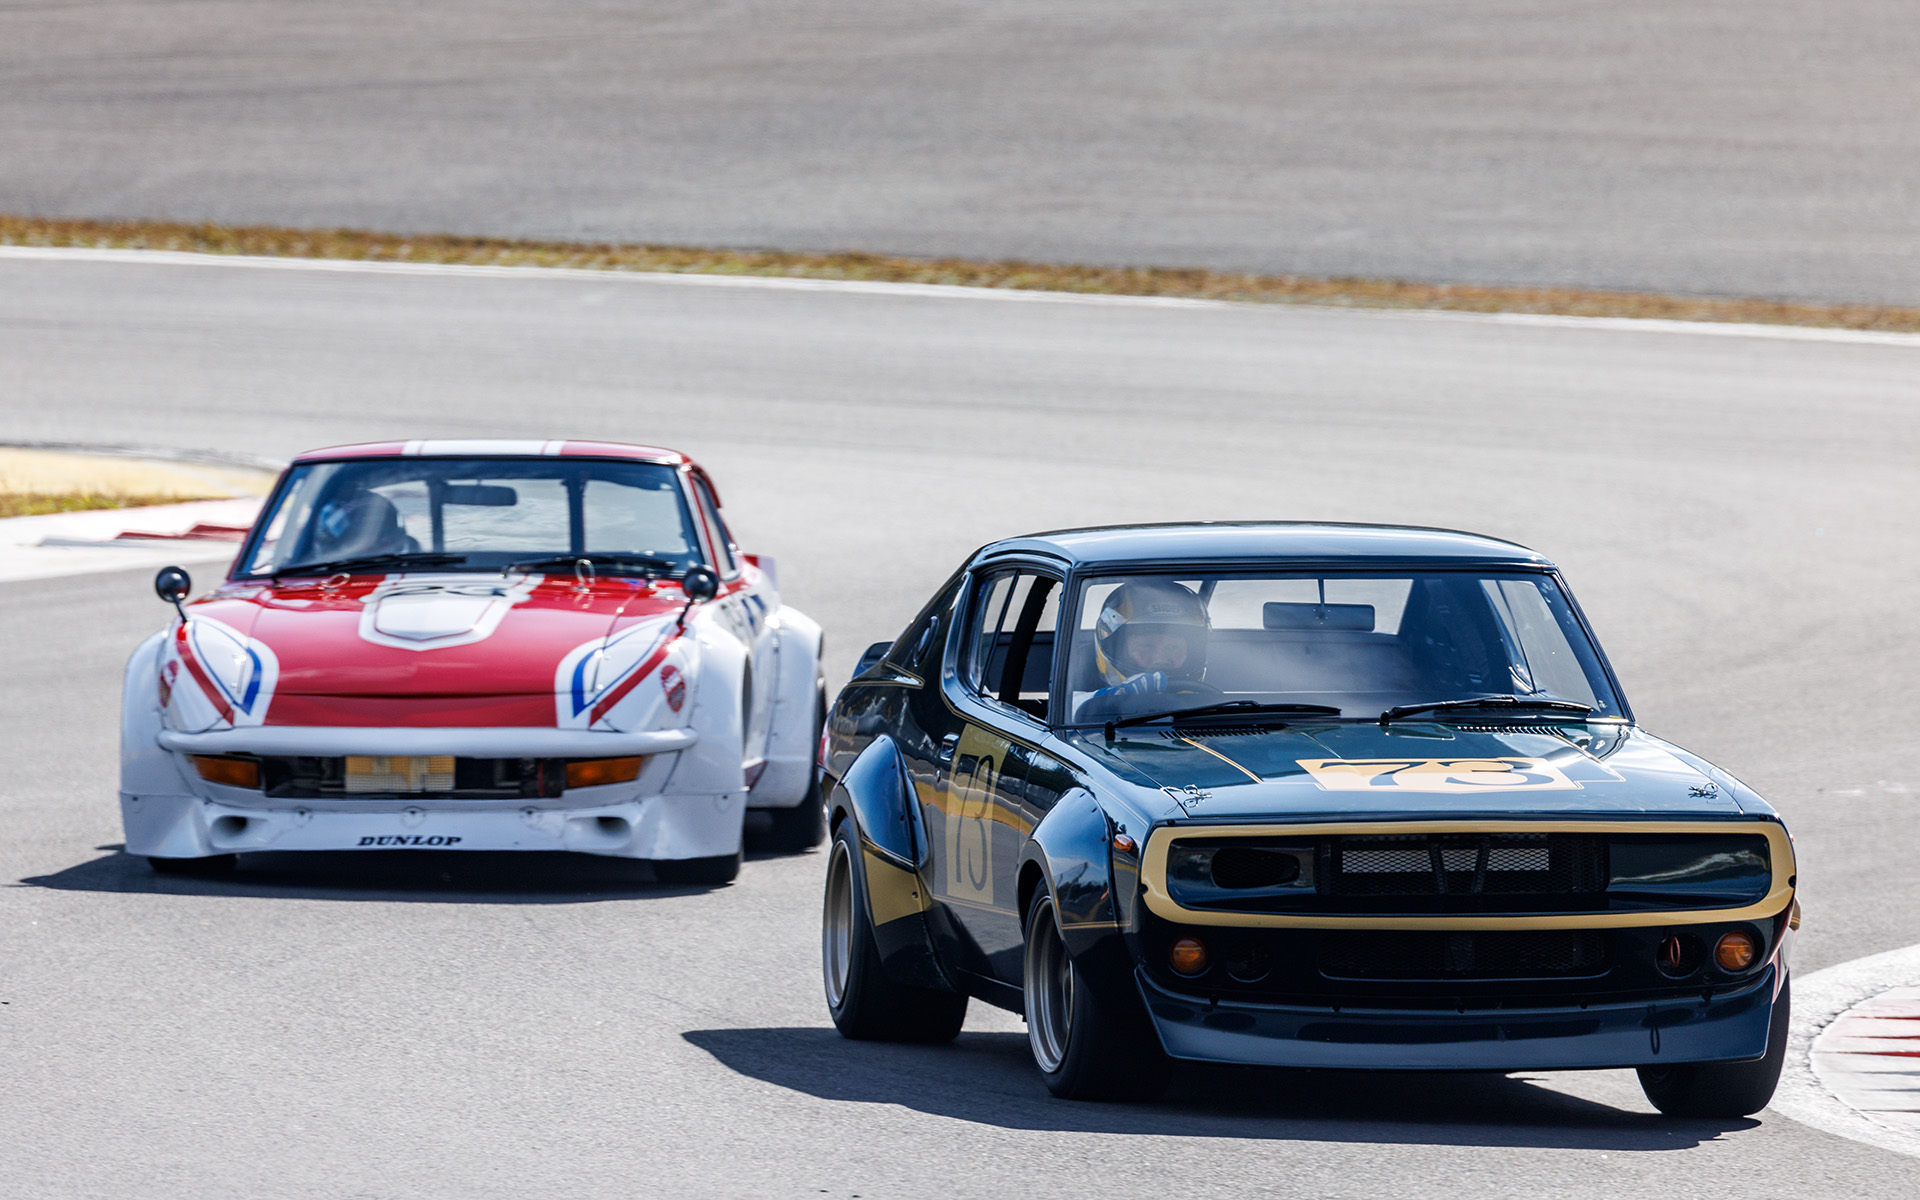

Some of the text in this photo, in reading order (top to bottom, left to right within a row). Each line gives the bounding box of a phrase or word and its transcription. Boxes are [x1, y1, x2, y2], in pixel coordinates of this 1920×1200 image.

[1320, 760, 1555, 787] 73
[953, 753, 995, 891] 73
[357, 836, 462, 846] DUNLOP
